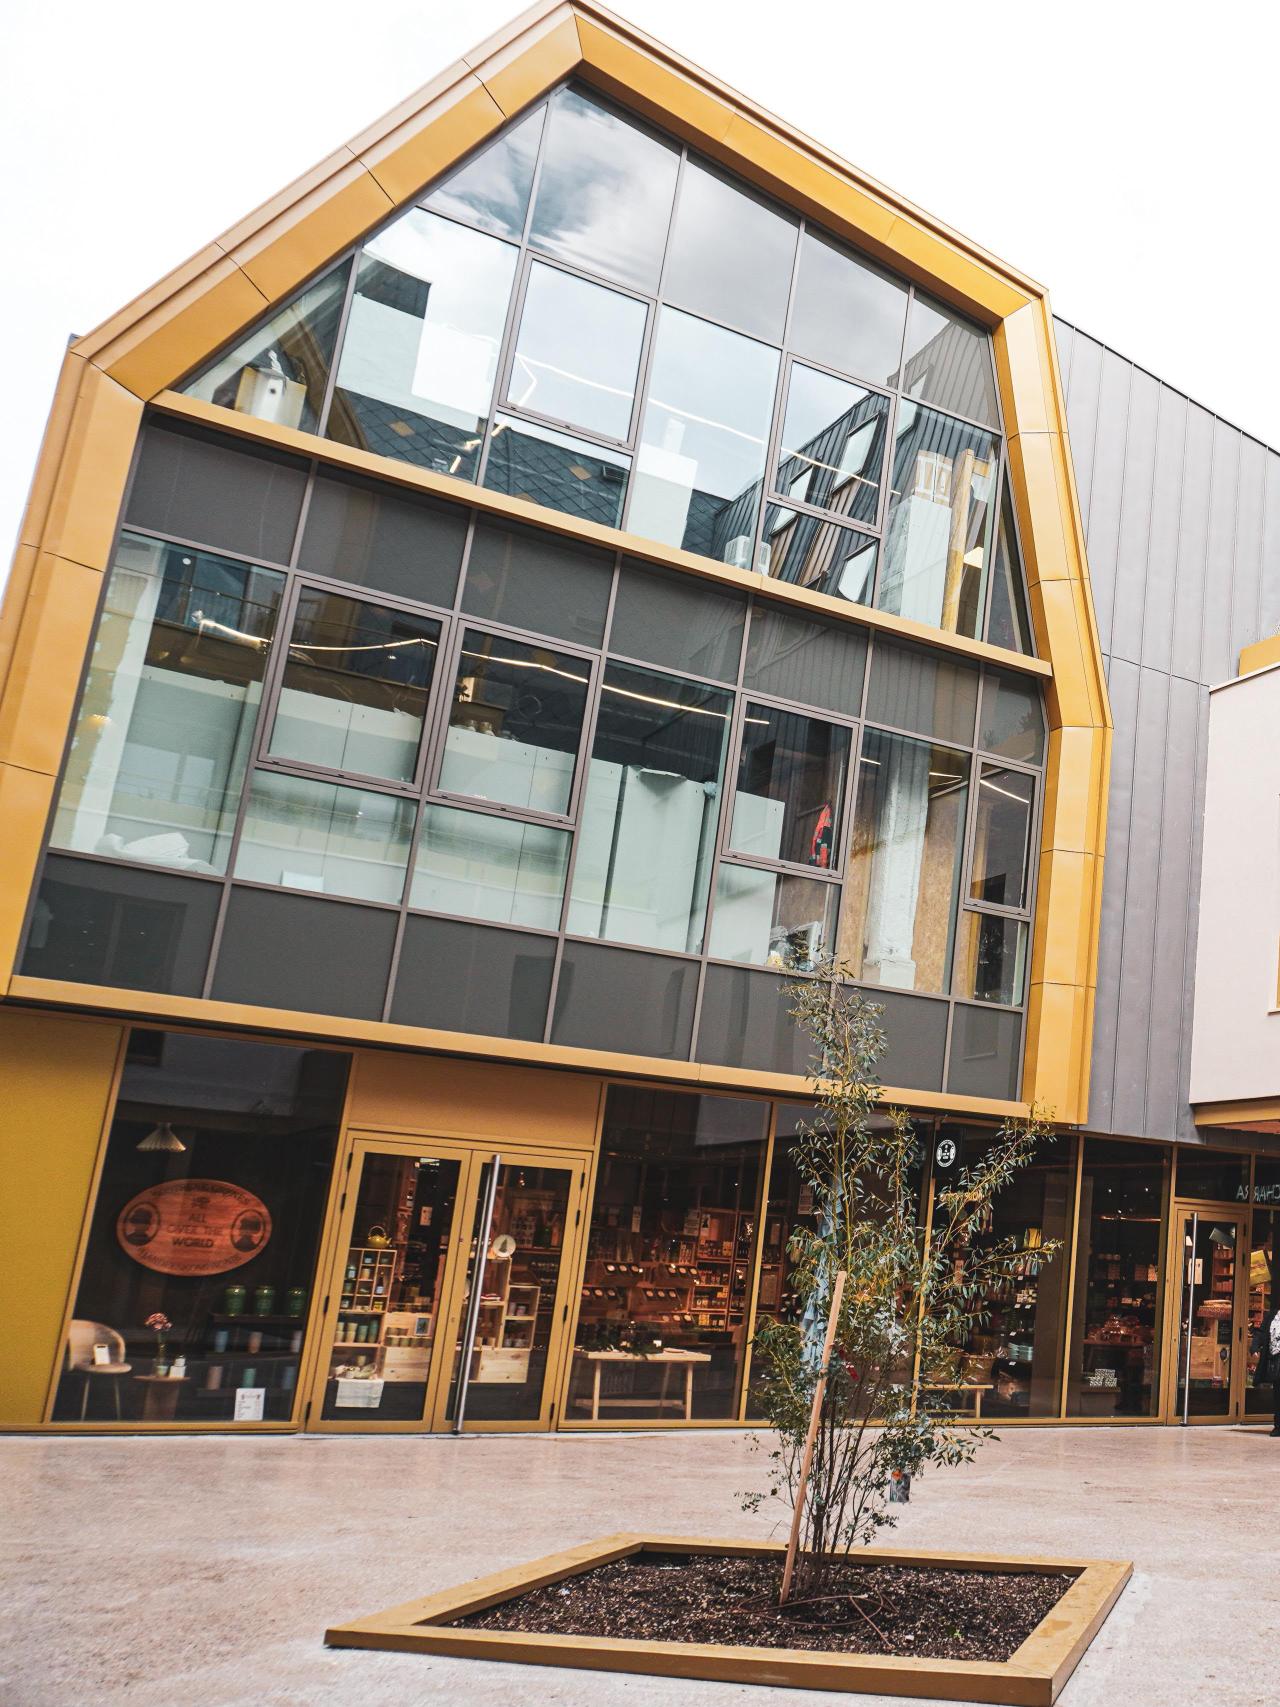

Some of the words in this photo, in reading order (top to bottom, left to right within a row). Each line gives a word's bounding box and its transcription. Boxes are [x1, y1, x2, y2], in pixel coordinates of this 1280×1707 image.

[189, 1213, 206, 1224] ALL
[204, 1226, 223, 1236] THE
[172, 1237, 214, 1249] WORLD
